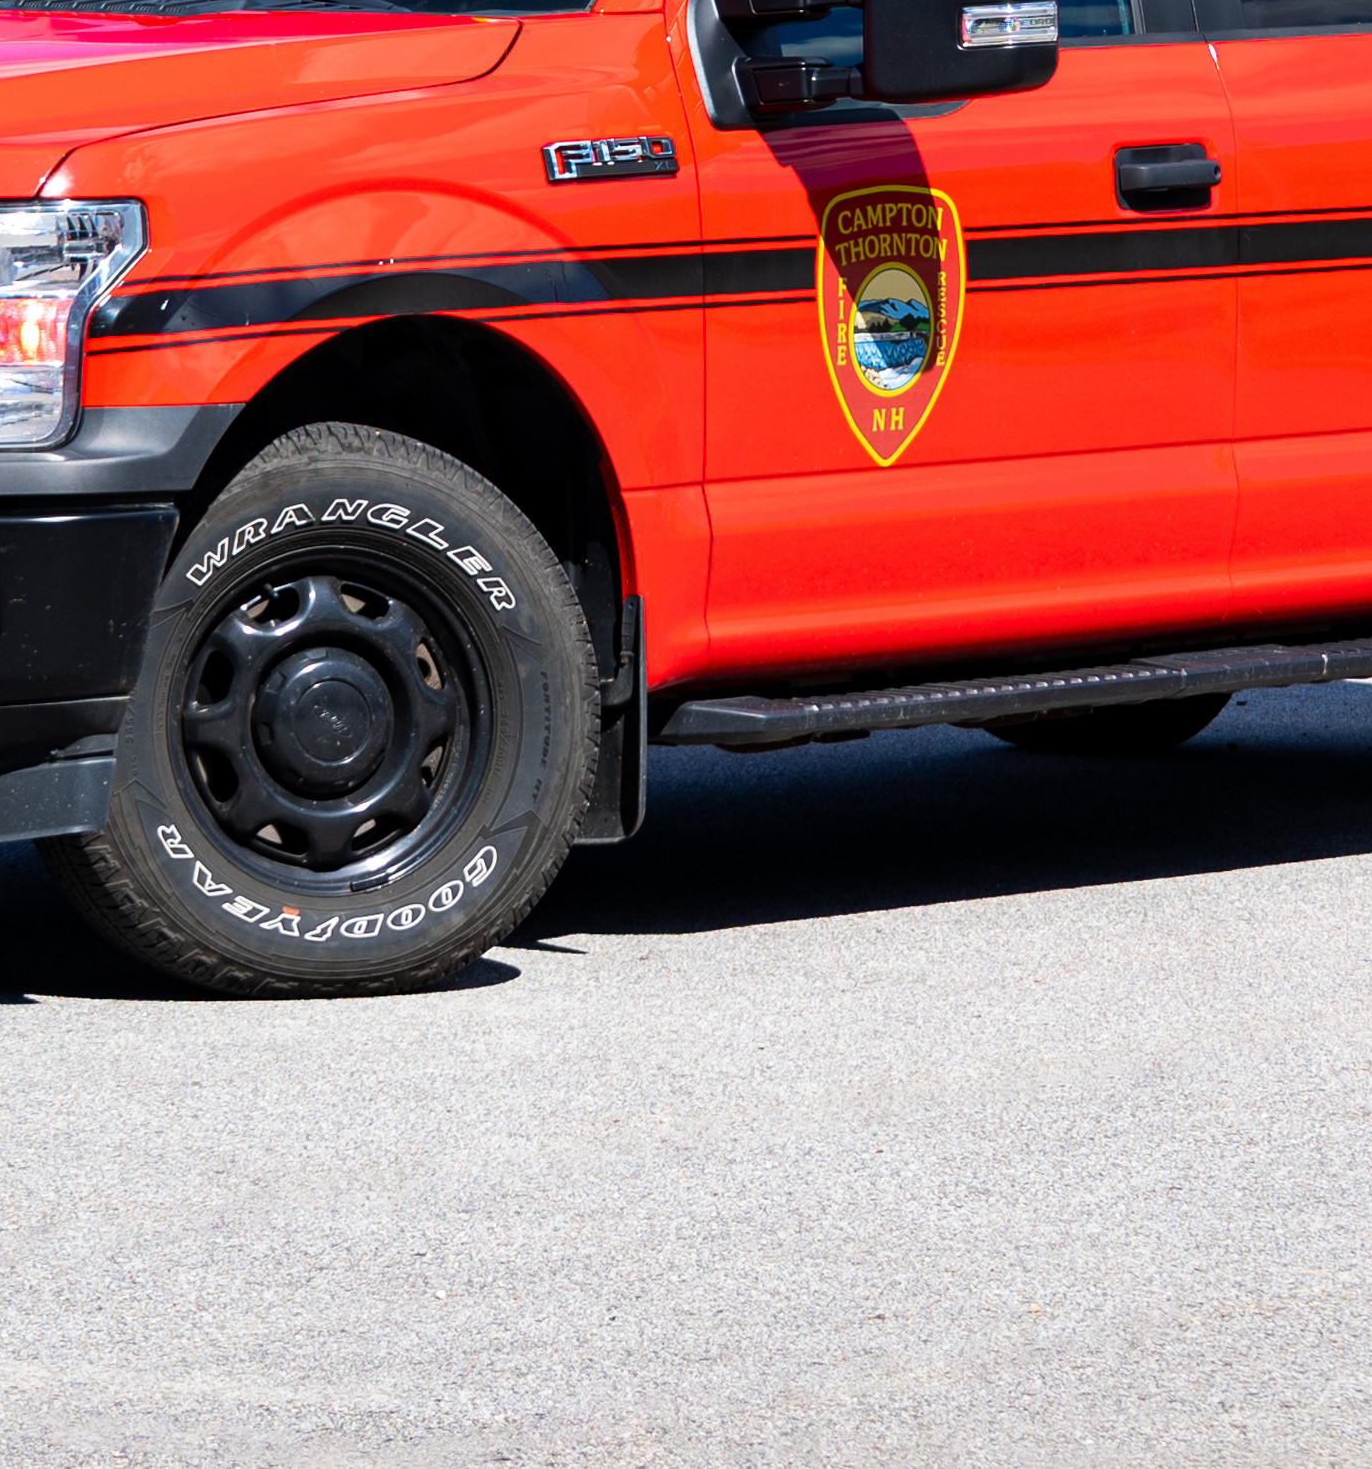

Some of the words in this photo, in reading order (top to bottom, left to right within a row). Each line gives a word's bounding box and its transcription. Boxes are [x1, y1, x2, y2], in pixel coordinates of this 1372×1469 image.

[835, 233, 947, 266] THORNTON
[837, 203, 944, 235] CAMPTON
[836, 277, 848, 367] FIRE
[935, 271, 948, 367] RESCUE
[186, 498, 517, 612] WRANGLER
[157, 823, 499, 942] GOODYEAR
